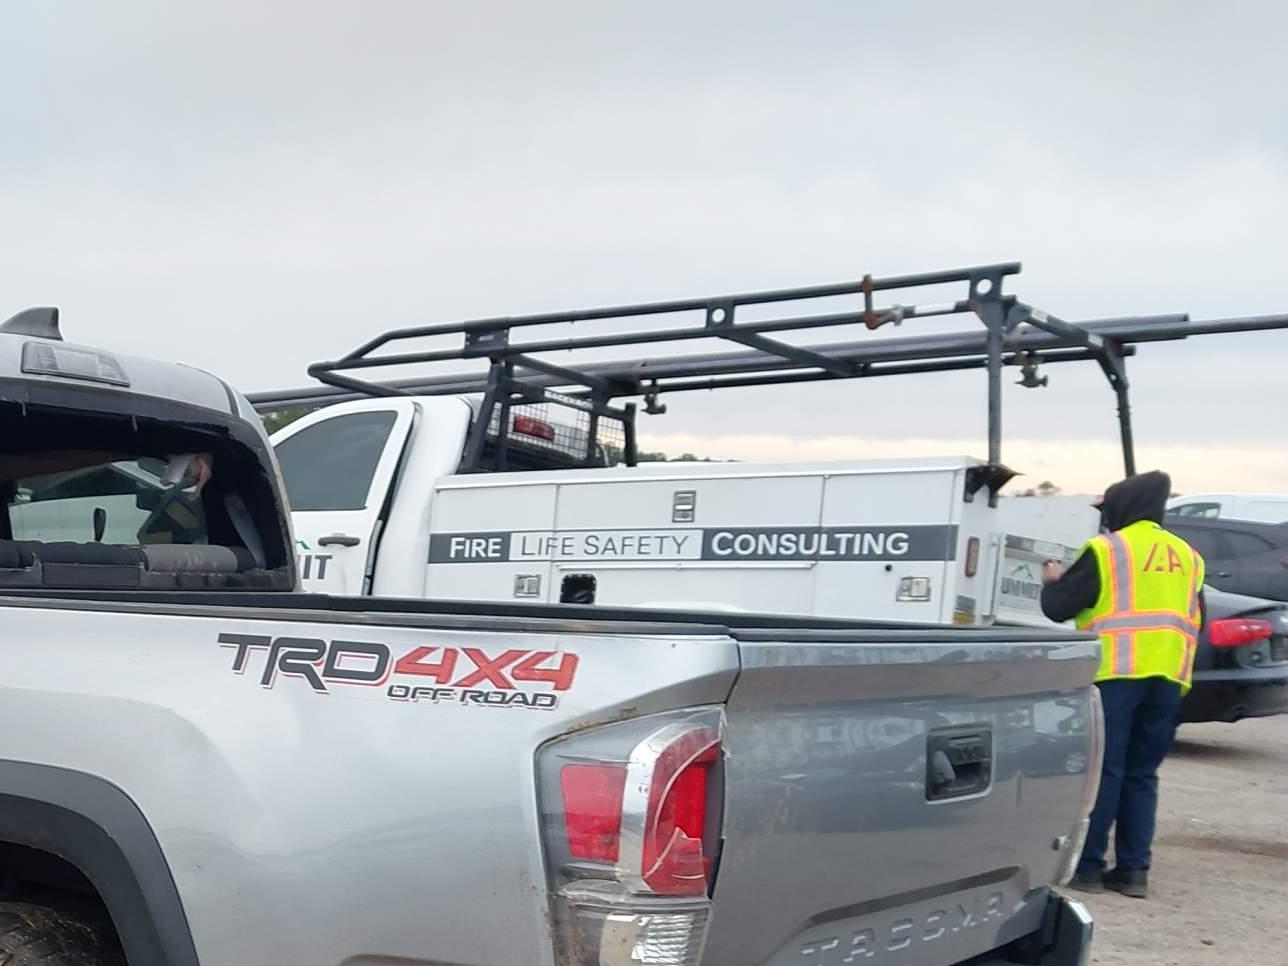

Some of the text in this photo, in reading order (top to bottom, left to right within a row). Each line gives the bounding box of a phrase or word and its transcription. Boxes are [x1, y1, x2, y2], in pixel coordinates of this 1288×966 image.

[449, 532, 910, 559] FIRE LIFE SAFETY CONSULTING
[217, 633, 393, 695] TRD
[386, 684, 559, 711] OFF ROAD
